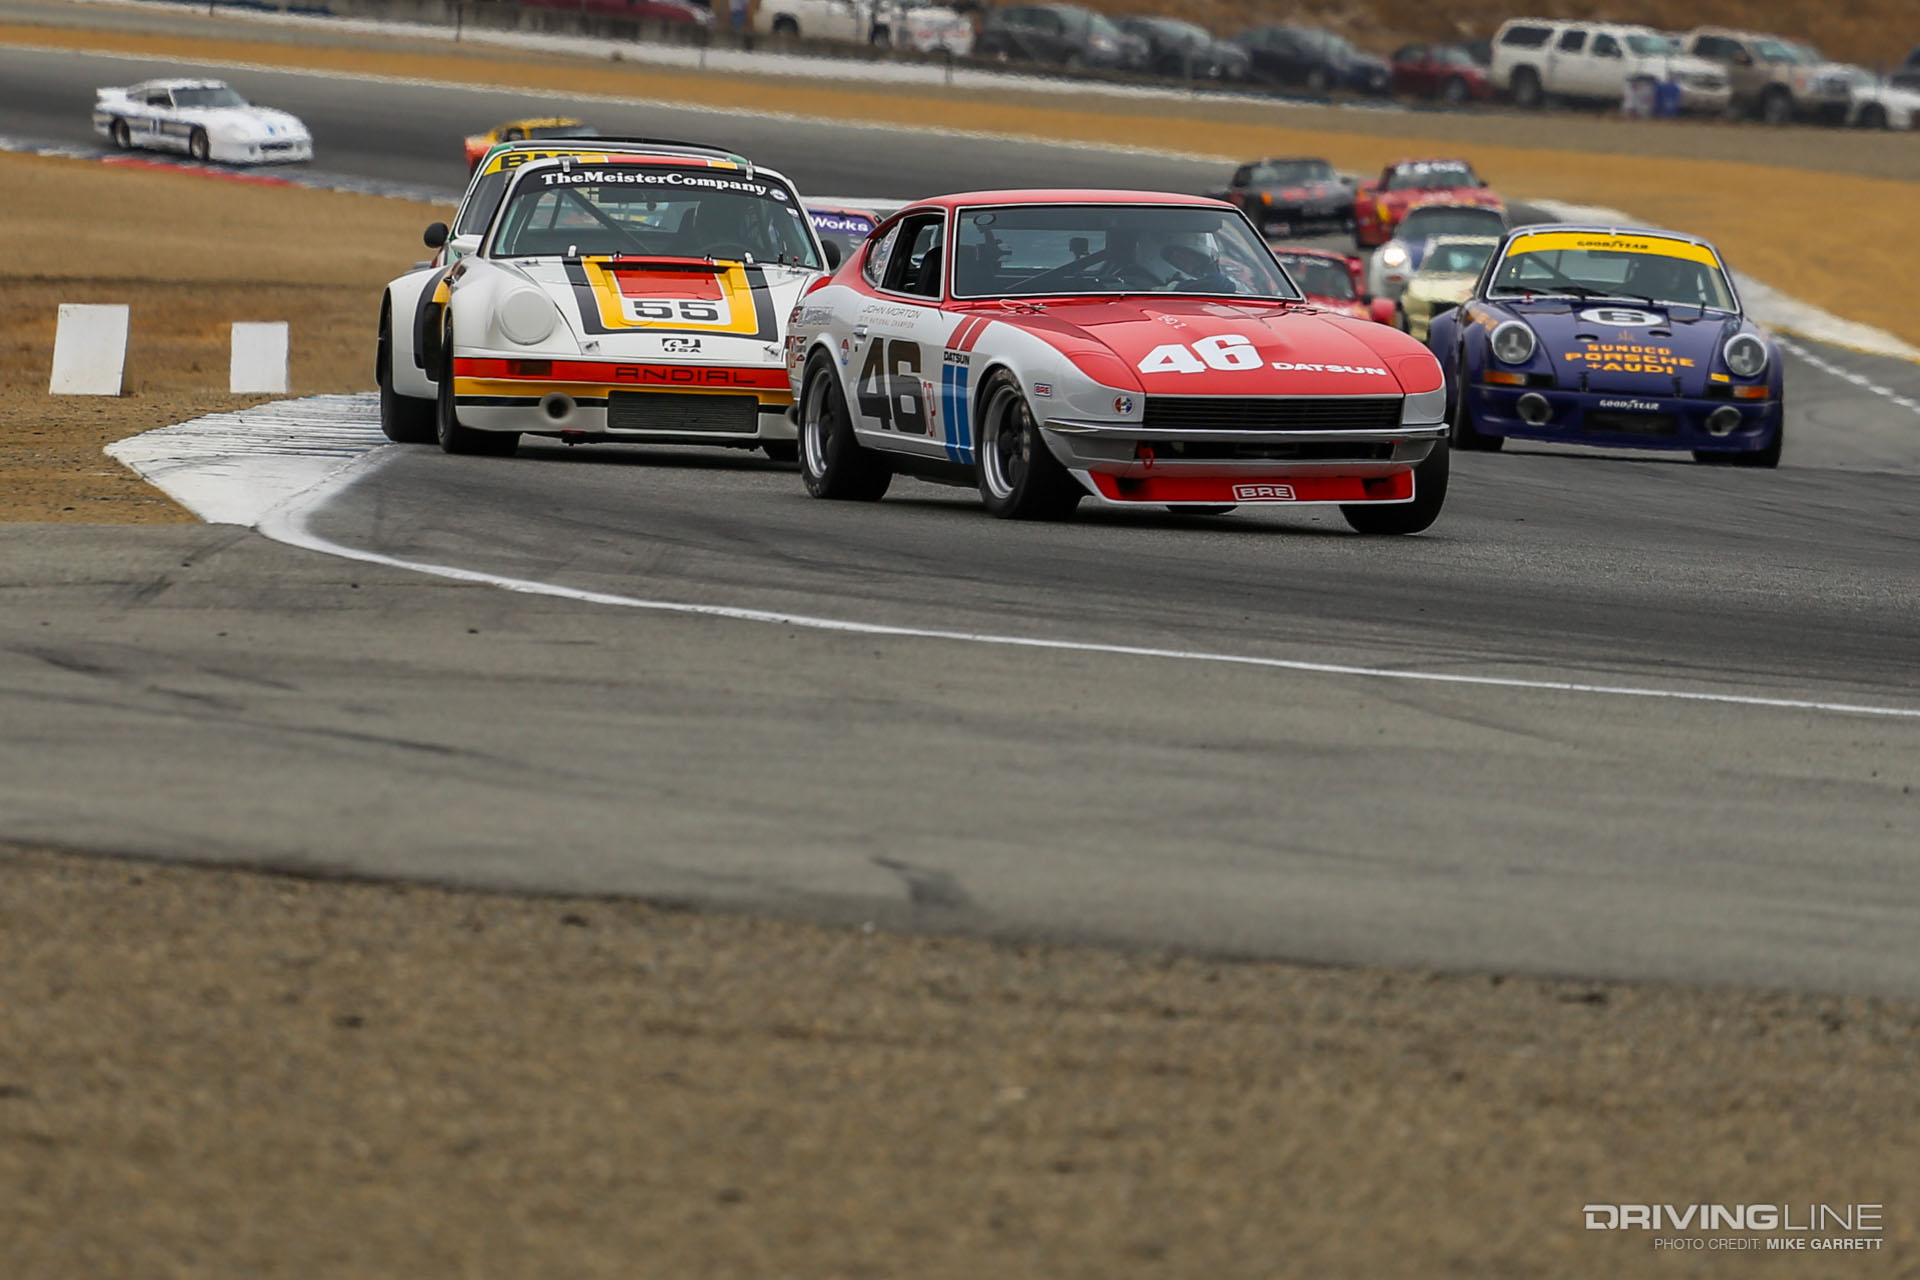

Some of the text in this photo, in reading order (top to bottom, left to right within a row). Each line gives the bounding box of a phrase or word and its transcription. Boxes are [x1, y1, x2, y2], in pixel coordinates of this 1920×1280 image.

[541, 170, 767, 196] TheMeisterCompany
[808, 216, 869, 232] Works
[633, 301, 719, 321] 55
[862, 304, 921, 319] JOHN MORTON
[1598, 311, 1645, 322] 6
[1137, 334, 1264, 374] 46
[1587, 344, 1671, 355] SUNOCO
[943, 351, 970, 365] DATSUN
[1565, 352, 1695, 367] PORSCHE
[616, 367, 756, 384] ANDIAL
[1271, 361, 1387, 376] DATSUN
[857, 337, 927, 435] 46
[1240, 487, 1290, 497] BRE
